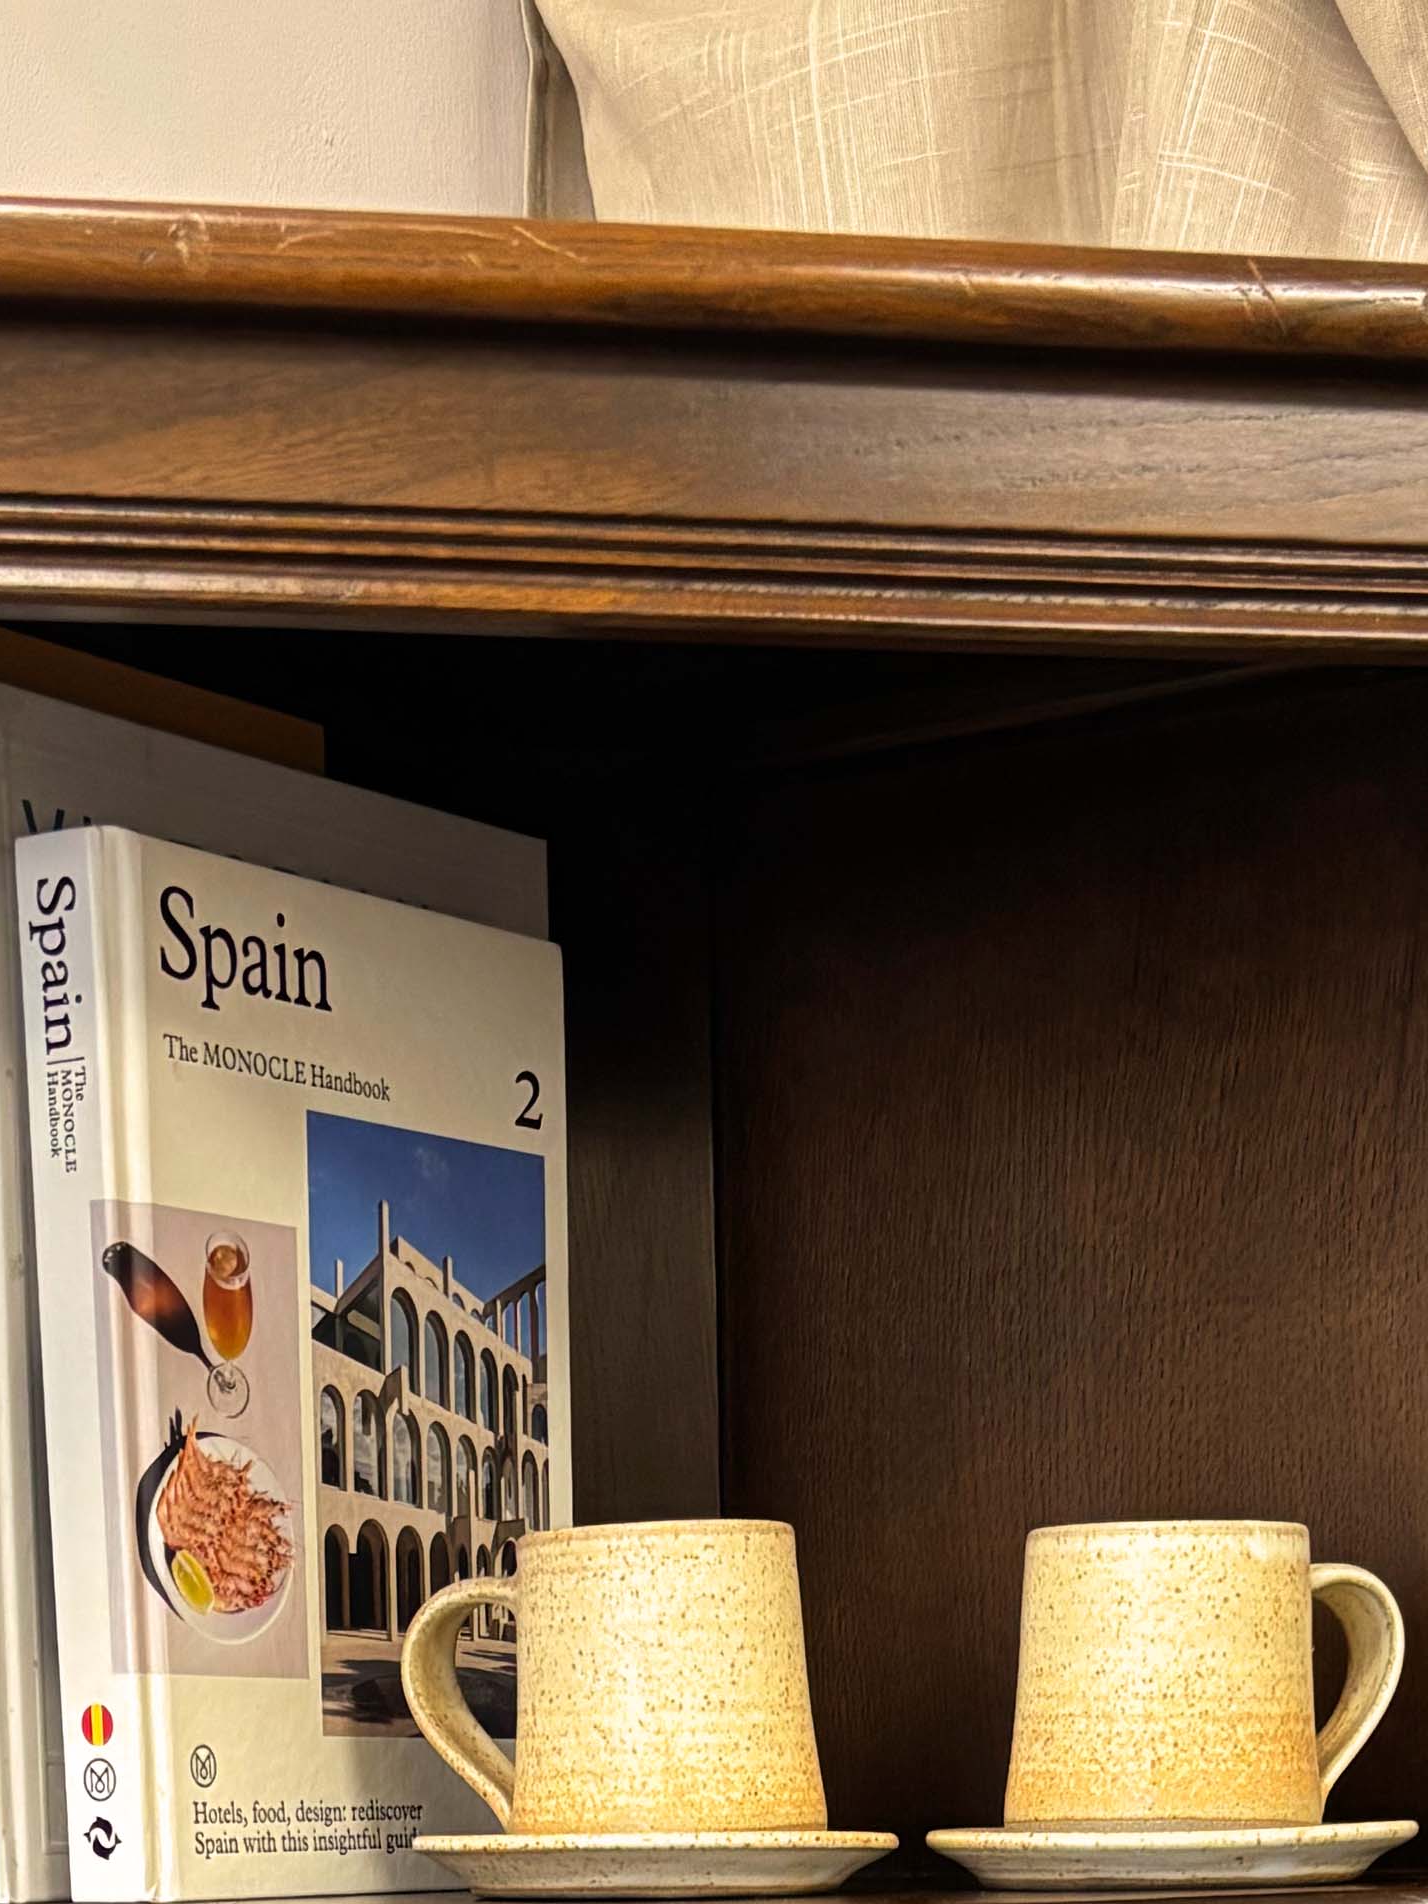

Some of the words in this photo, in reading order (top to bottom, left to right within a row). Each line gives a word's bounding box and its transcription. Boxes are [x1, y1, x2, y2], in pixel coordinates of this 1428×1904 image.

[28, 875, 83, 1056] Spain
[159, 885, 333, 1012] Spain
[74, 1065, 87, 1102] The
[162, 1033, 199, 1064] The
[202, 1041, 307, 1086] MONOCLE
[310, 1064, 391, 1102] Handbook
[514, 1070, 544, 1131] 2
[46, 1070, 63, 1159] Handbook
[60, 1068, 78, 1174] MONOCLE
[192, 1800, 249, 1828] Hotels,
[252, 1800, 292, 1827] food,
[295, 1799, 347, 1827] design:
[351, 1797, 423, 1822] rediscover
[194, 1831, 239, 1859] Spain
[243, 1829, 278, 1854] with
[281, 1829, 309, 1852] this
[312, 1828, 382, 1856] insightful
[386, 1826, 419, 1854] guid
